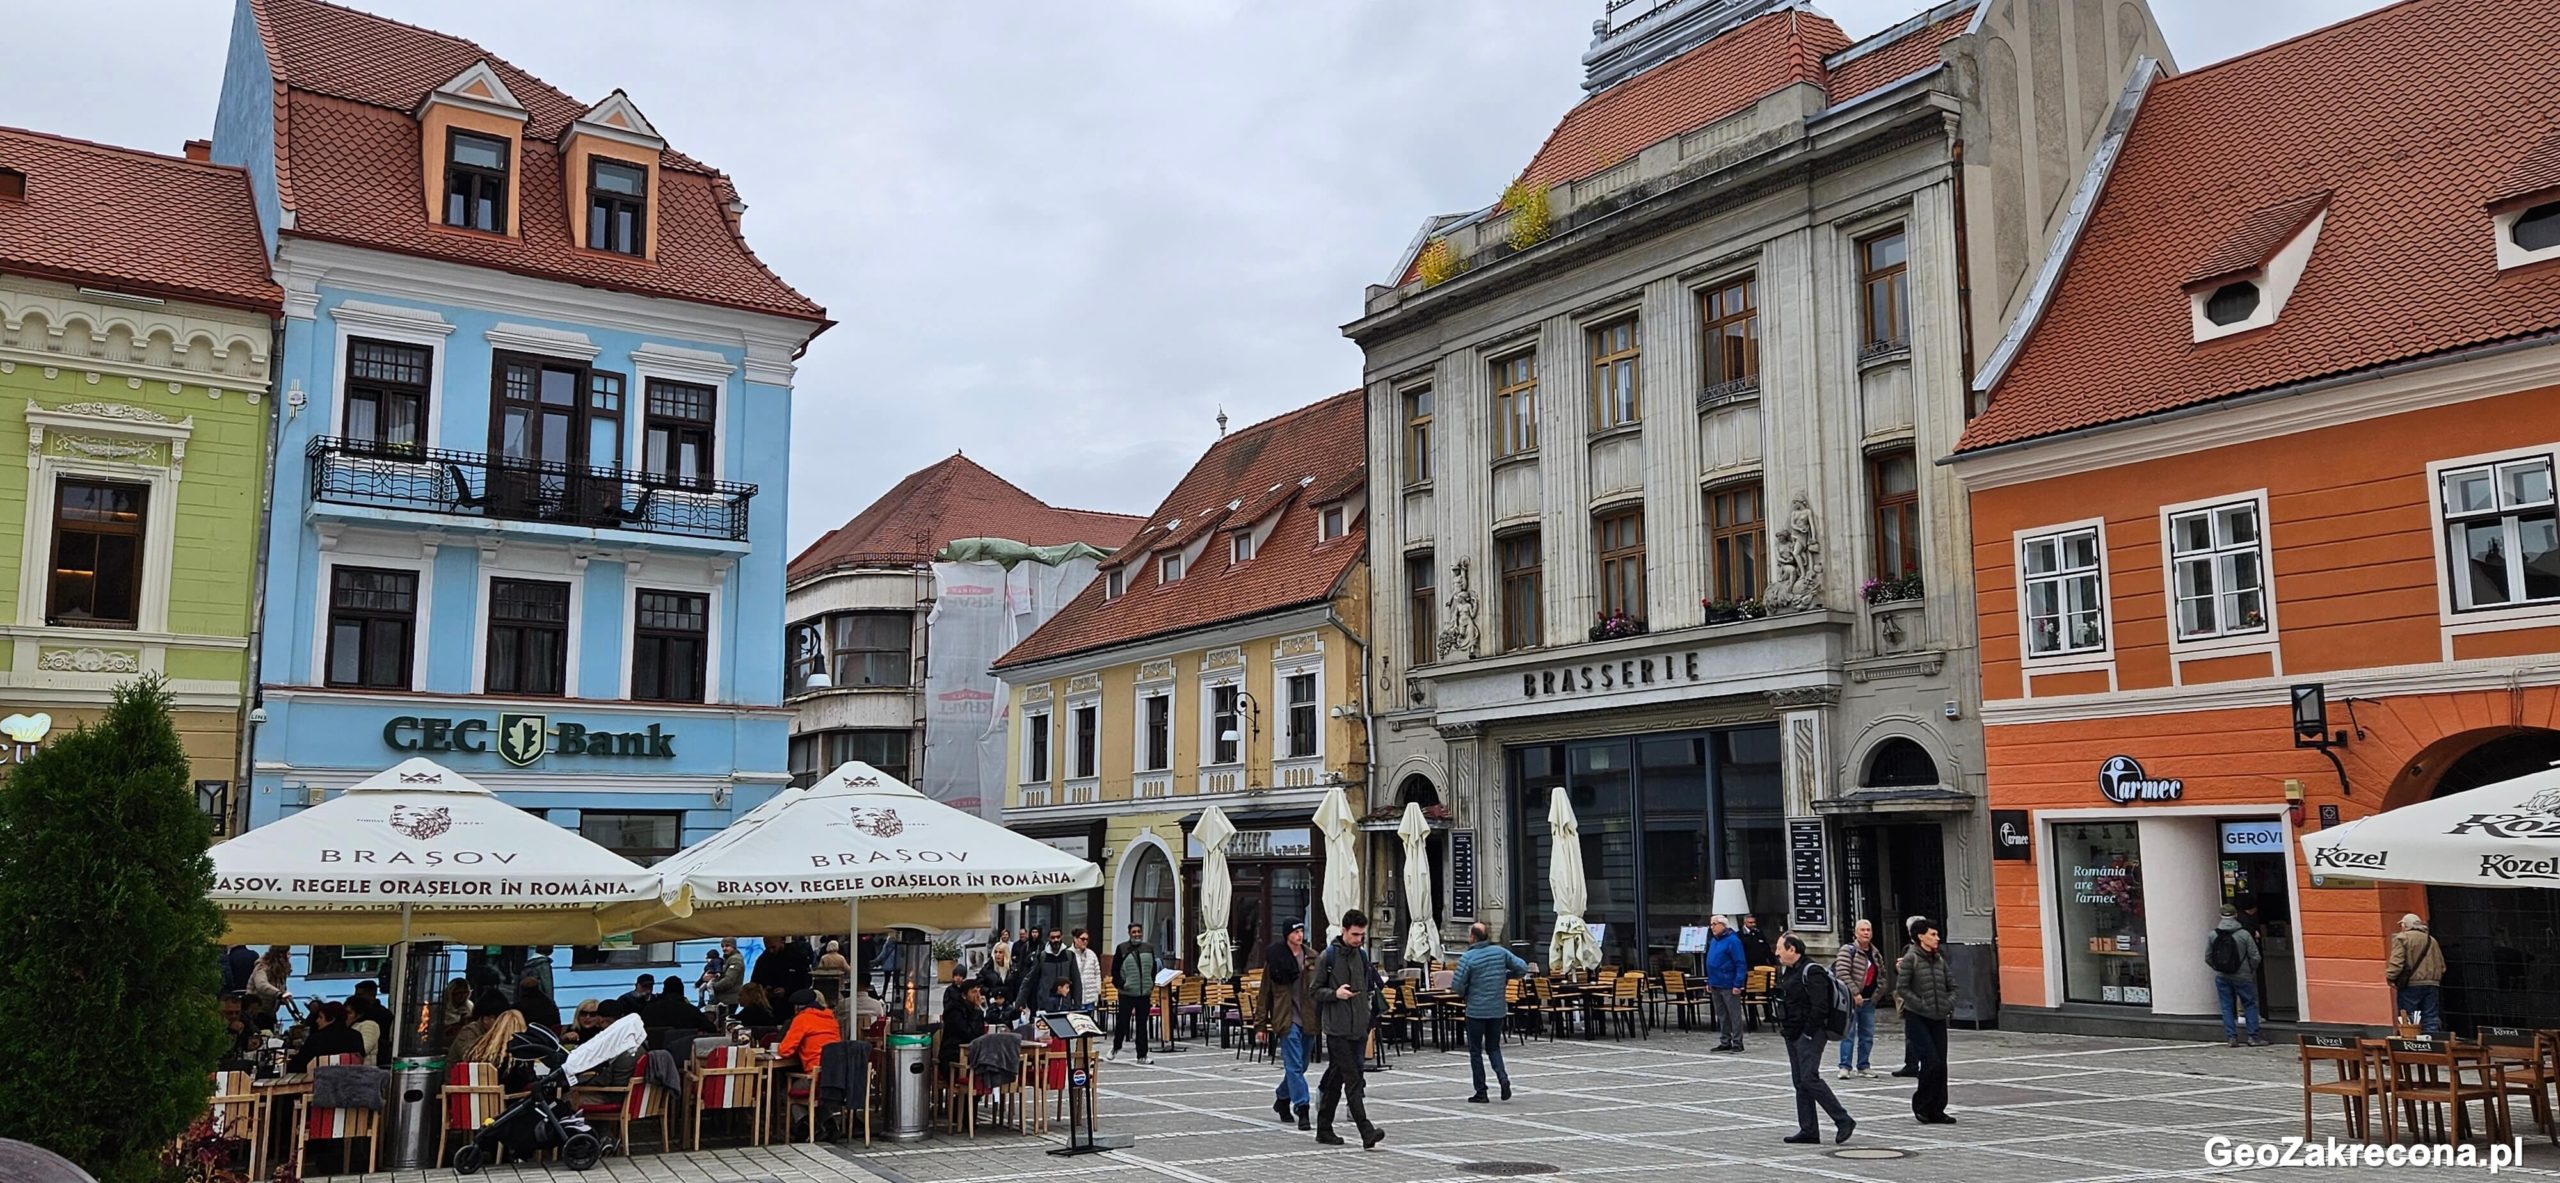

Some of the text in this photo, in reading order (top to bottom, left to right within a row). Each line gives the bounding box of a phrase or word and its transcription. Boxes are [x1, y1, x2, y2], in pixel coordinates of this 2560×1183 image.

[1523, 652, 1700, 697] BRASSERIE
[383, 715, 677, 757] CEC Bank
[321, 850, 517, 868] BRAȘOV
[811, 849, 968, 868] BRAȘOV
[2314, 847, 2388, 869] Kozel
[2478, 854, 2560, 880] Kozel
[2073, 865, 2126, 877] România
[292, 879, 371, 894] REGELE
[380, 880, 492, 898] ORAȘELOR
[501, 879, 522, 896] ÎN
[530, 879, 636, 896] ROMÂNIA.
[717, 871, 1076, 896] BRAȘOV. REGELE ORAȘELOR ÎN ROMÂNIA.
[2074, 880, 2093, 890] are
[2075, 892, 2116, 904] farmec
[2493, 1026, 2519, 1037] Kozel
[2315, 1035, 2344, 1047] Kozel
[2403, 1040, 2432, 1052] Kozel
